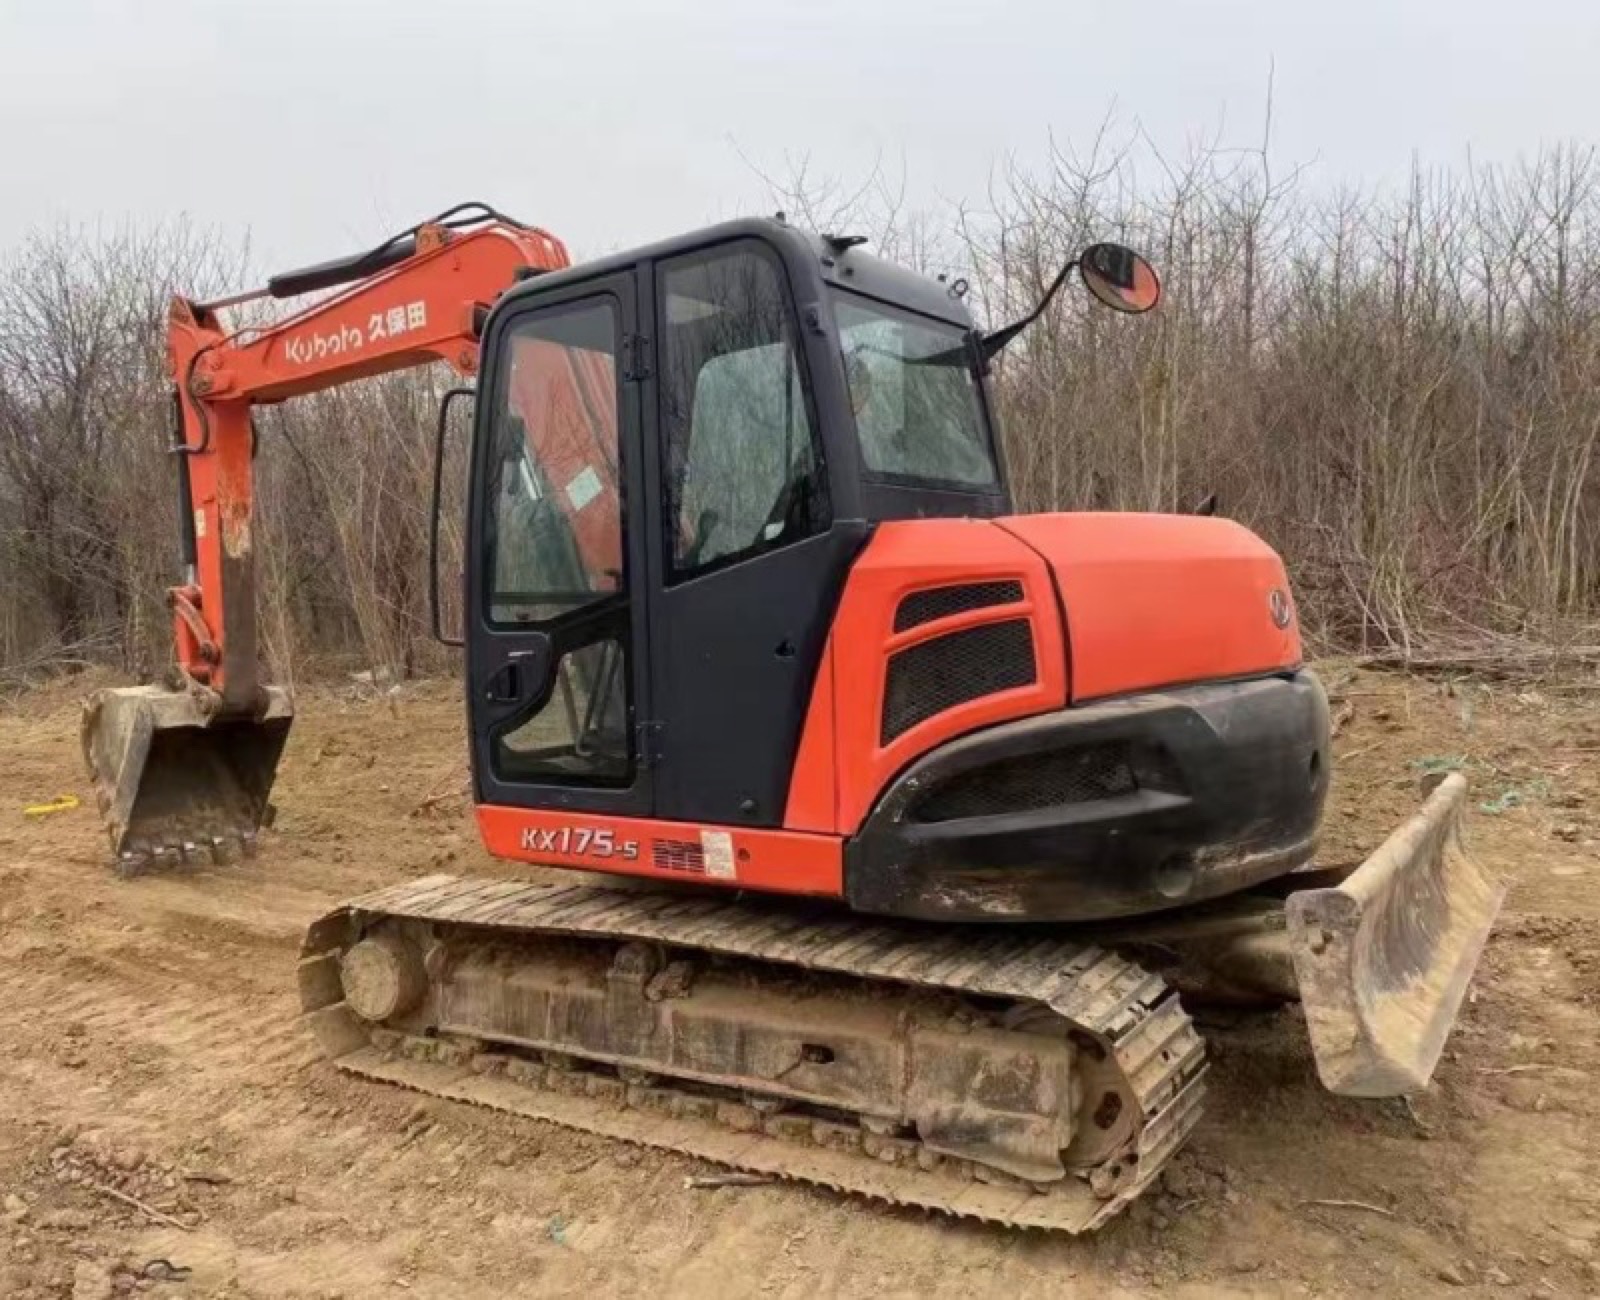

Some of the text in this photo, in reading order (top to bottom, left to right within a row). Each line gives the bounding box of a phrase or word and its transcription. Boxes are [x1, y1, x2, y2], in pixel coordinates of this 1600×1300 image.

[285, 300, 426, 363] Kubota 久保田
